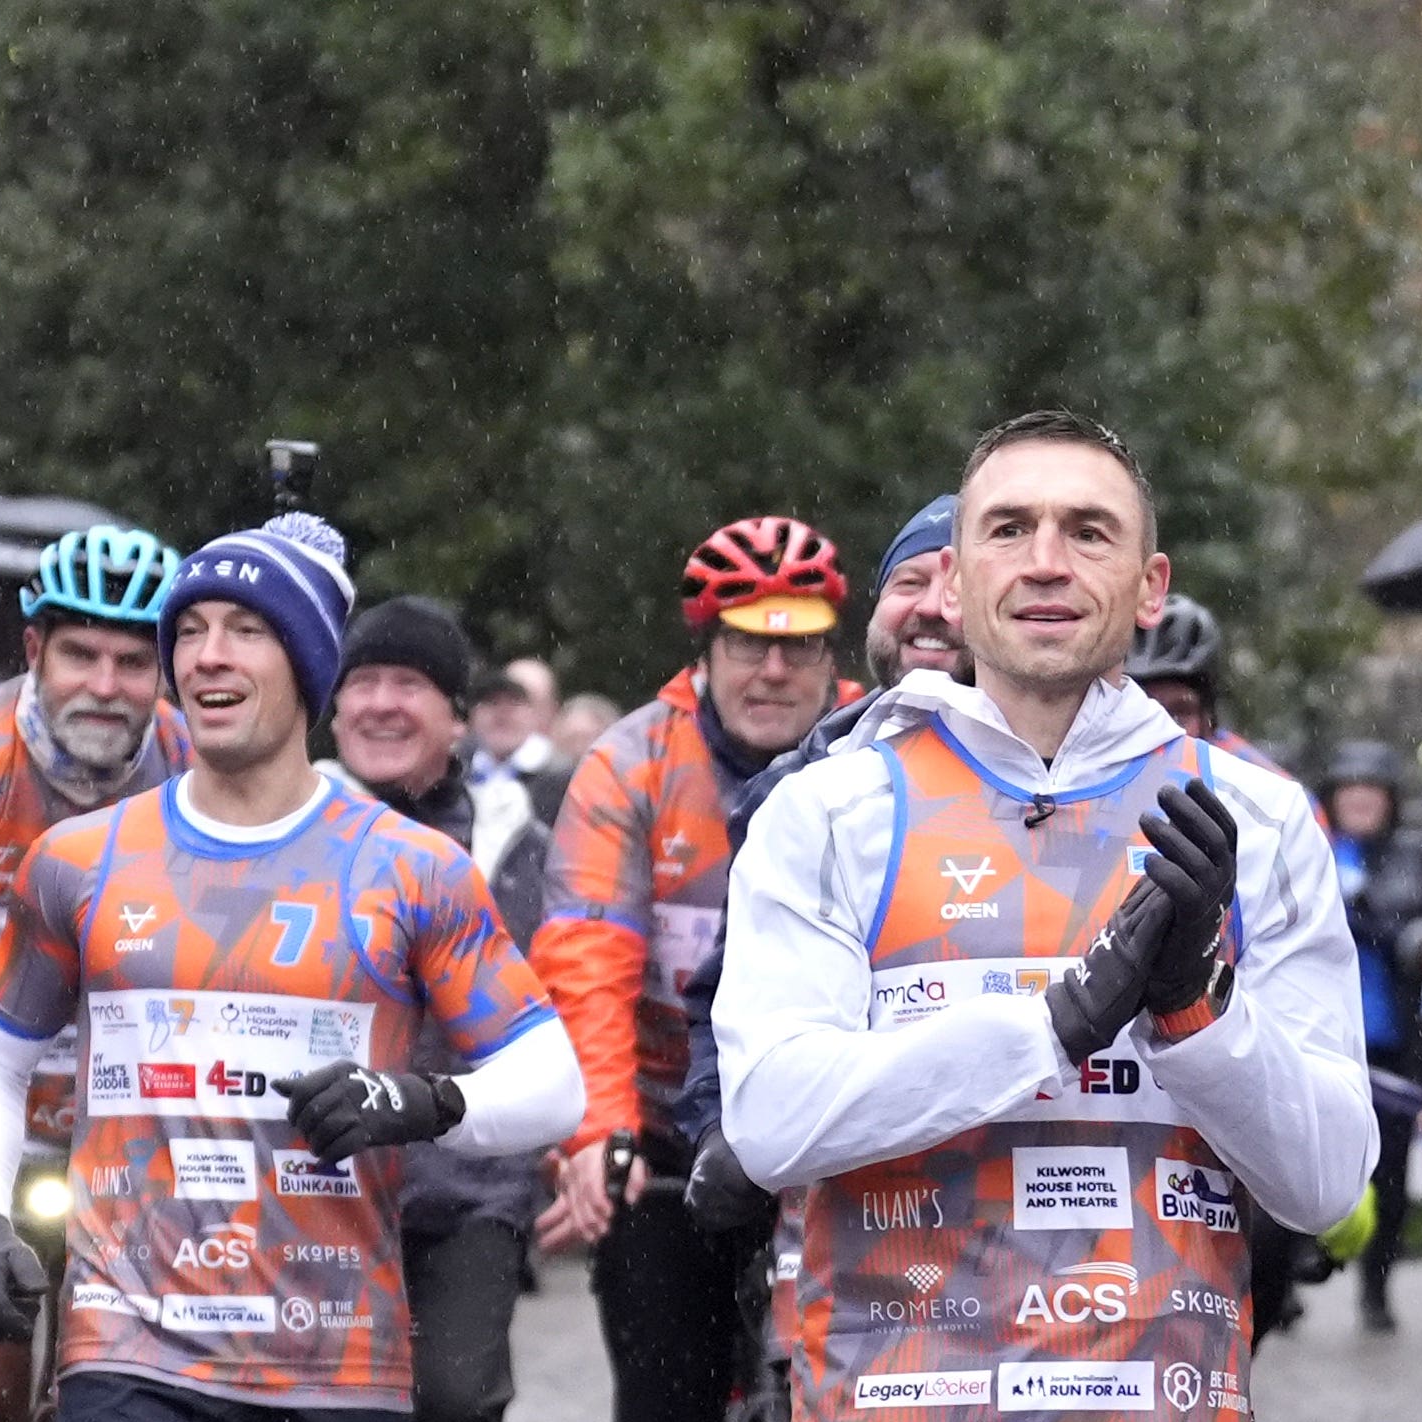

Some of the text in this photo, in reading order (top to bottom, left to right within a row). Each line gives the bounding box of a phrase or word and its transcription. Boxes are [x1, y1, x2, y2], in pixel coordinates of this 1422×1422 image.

[171, 559, 260, 591] XEN
[940, 903, 998, 919] OXEN
[269, 900, 318, 968] 7
[114, 938, 153, 951] OXEN
[876, 977, 946, 1004] mnda
[242, 1003, 276, 1014] Leeds
[246, 1014, 298, 1027] Hospitals
[249, 1026, 290, 1039] Charity
[206, 1060, 266, 1097] 4ED
[186, 1154, 237, 1163] KILWORTH
[178, 1164, 245, 1173] HOUSE HOTEL
[1037, 1167, 1105, 1178] KILWORTH
[203, 1176, 246, 1185] THEATRE
[281, 1175, 358, 1194] BUNKABIN
[1026, 1181, 1117, 1192] HOUSE HOTEL
[863, 1188, 943, 1231] EUAN'S
[1026, 1197, 1118, 1208] AND THEATRE
[1162, 1193, 1237, 1230] BUNBIN
[172, 1238, 251, 1268] ACS
[283, 1244, 360, 1262] SKOPES
[319, 1301, 353, 1314] BE THE
[870, 1297, 981, 1321] ROMERO
[1015, 1283, 1127, 1325] ACS
[1172, 1288, 1240, 1321] SKOPES
[198, 1312, 265, 1321] RUN FOR ALL
[319, 1315, 373, 1328] STANDARD
[1210, 1370, 1223, 1389] BE
[858, 1378, 987, 1401] LegacyLocker
[1050, 1385, 1141, 1396] RUN FOR ALL
